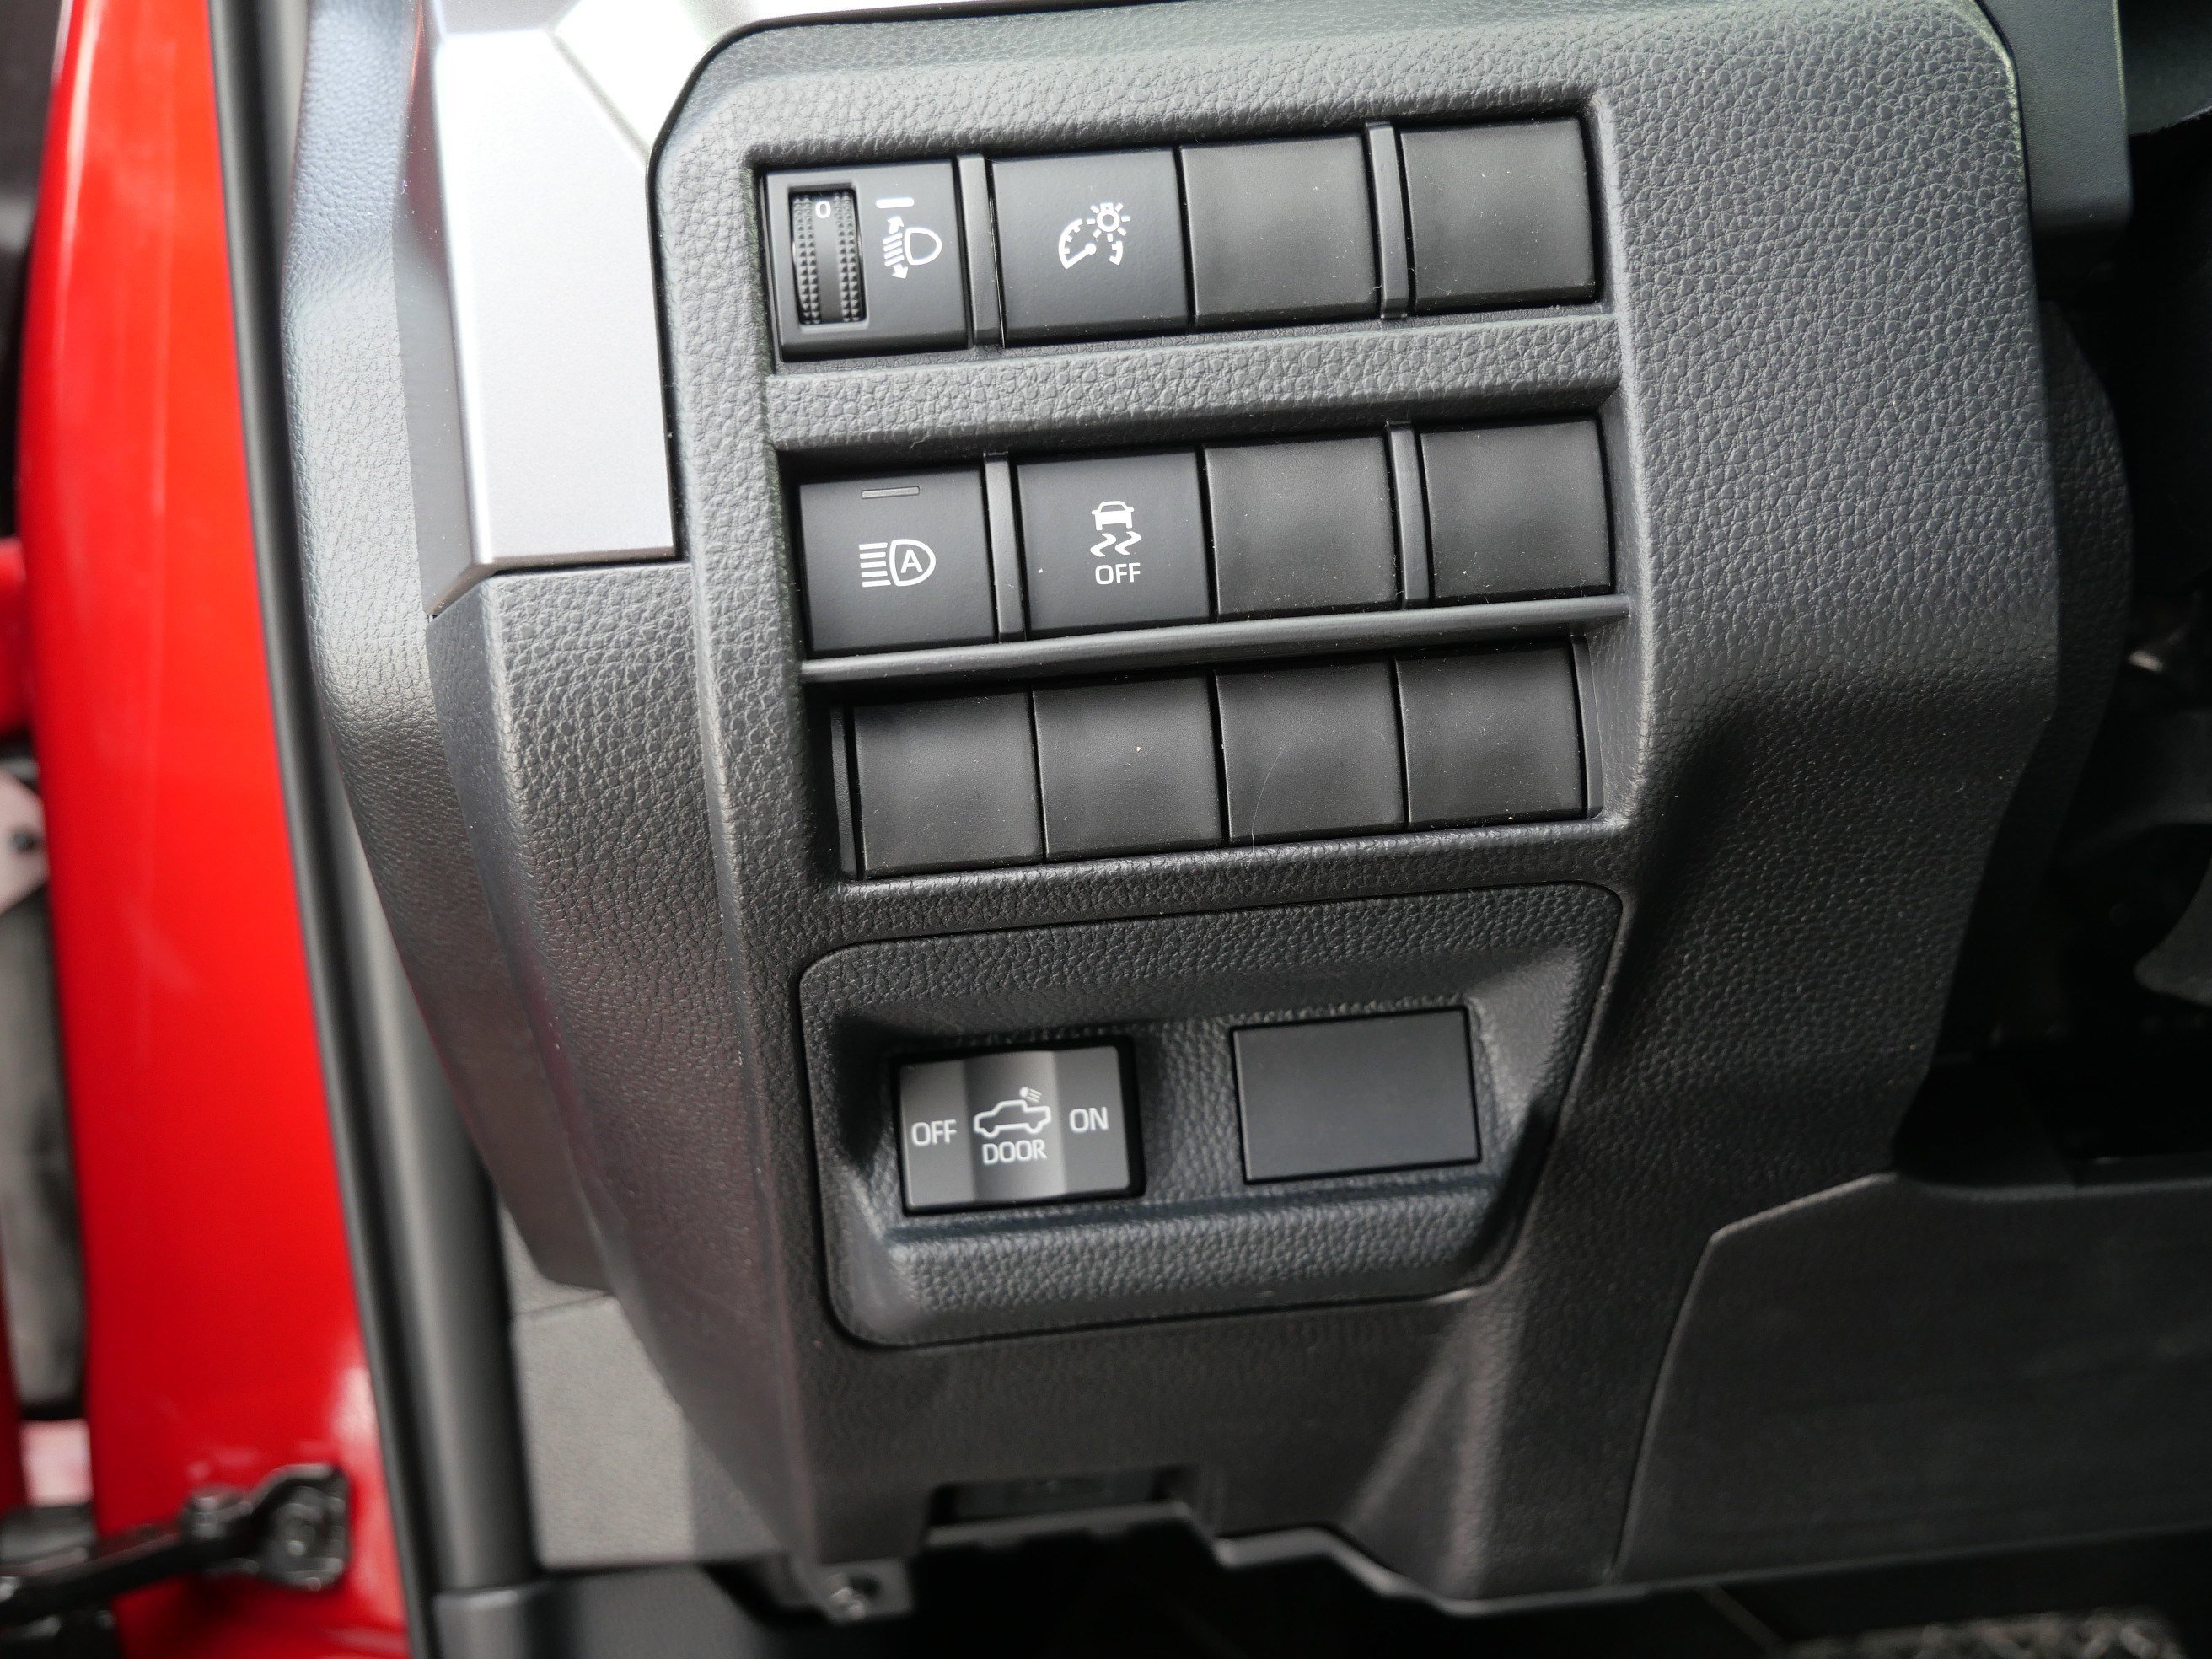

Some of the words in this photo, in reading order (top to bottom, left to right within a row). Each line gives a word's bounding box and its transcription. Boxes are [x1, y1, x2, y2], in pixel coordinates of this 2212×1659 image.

[815, 201, 831, 218] 0
[1095, 562, 1141, 585] OFF
[1069, 1106, 1109, 1133] ON
[910, 1119, 958, 1147] OFF
[982, 1139, 1048, 1165] DOOR
